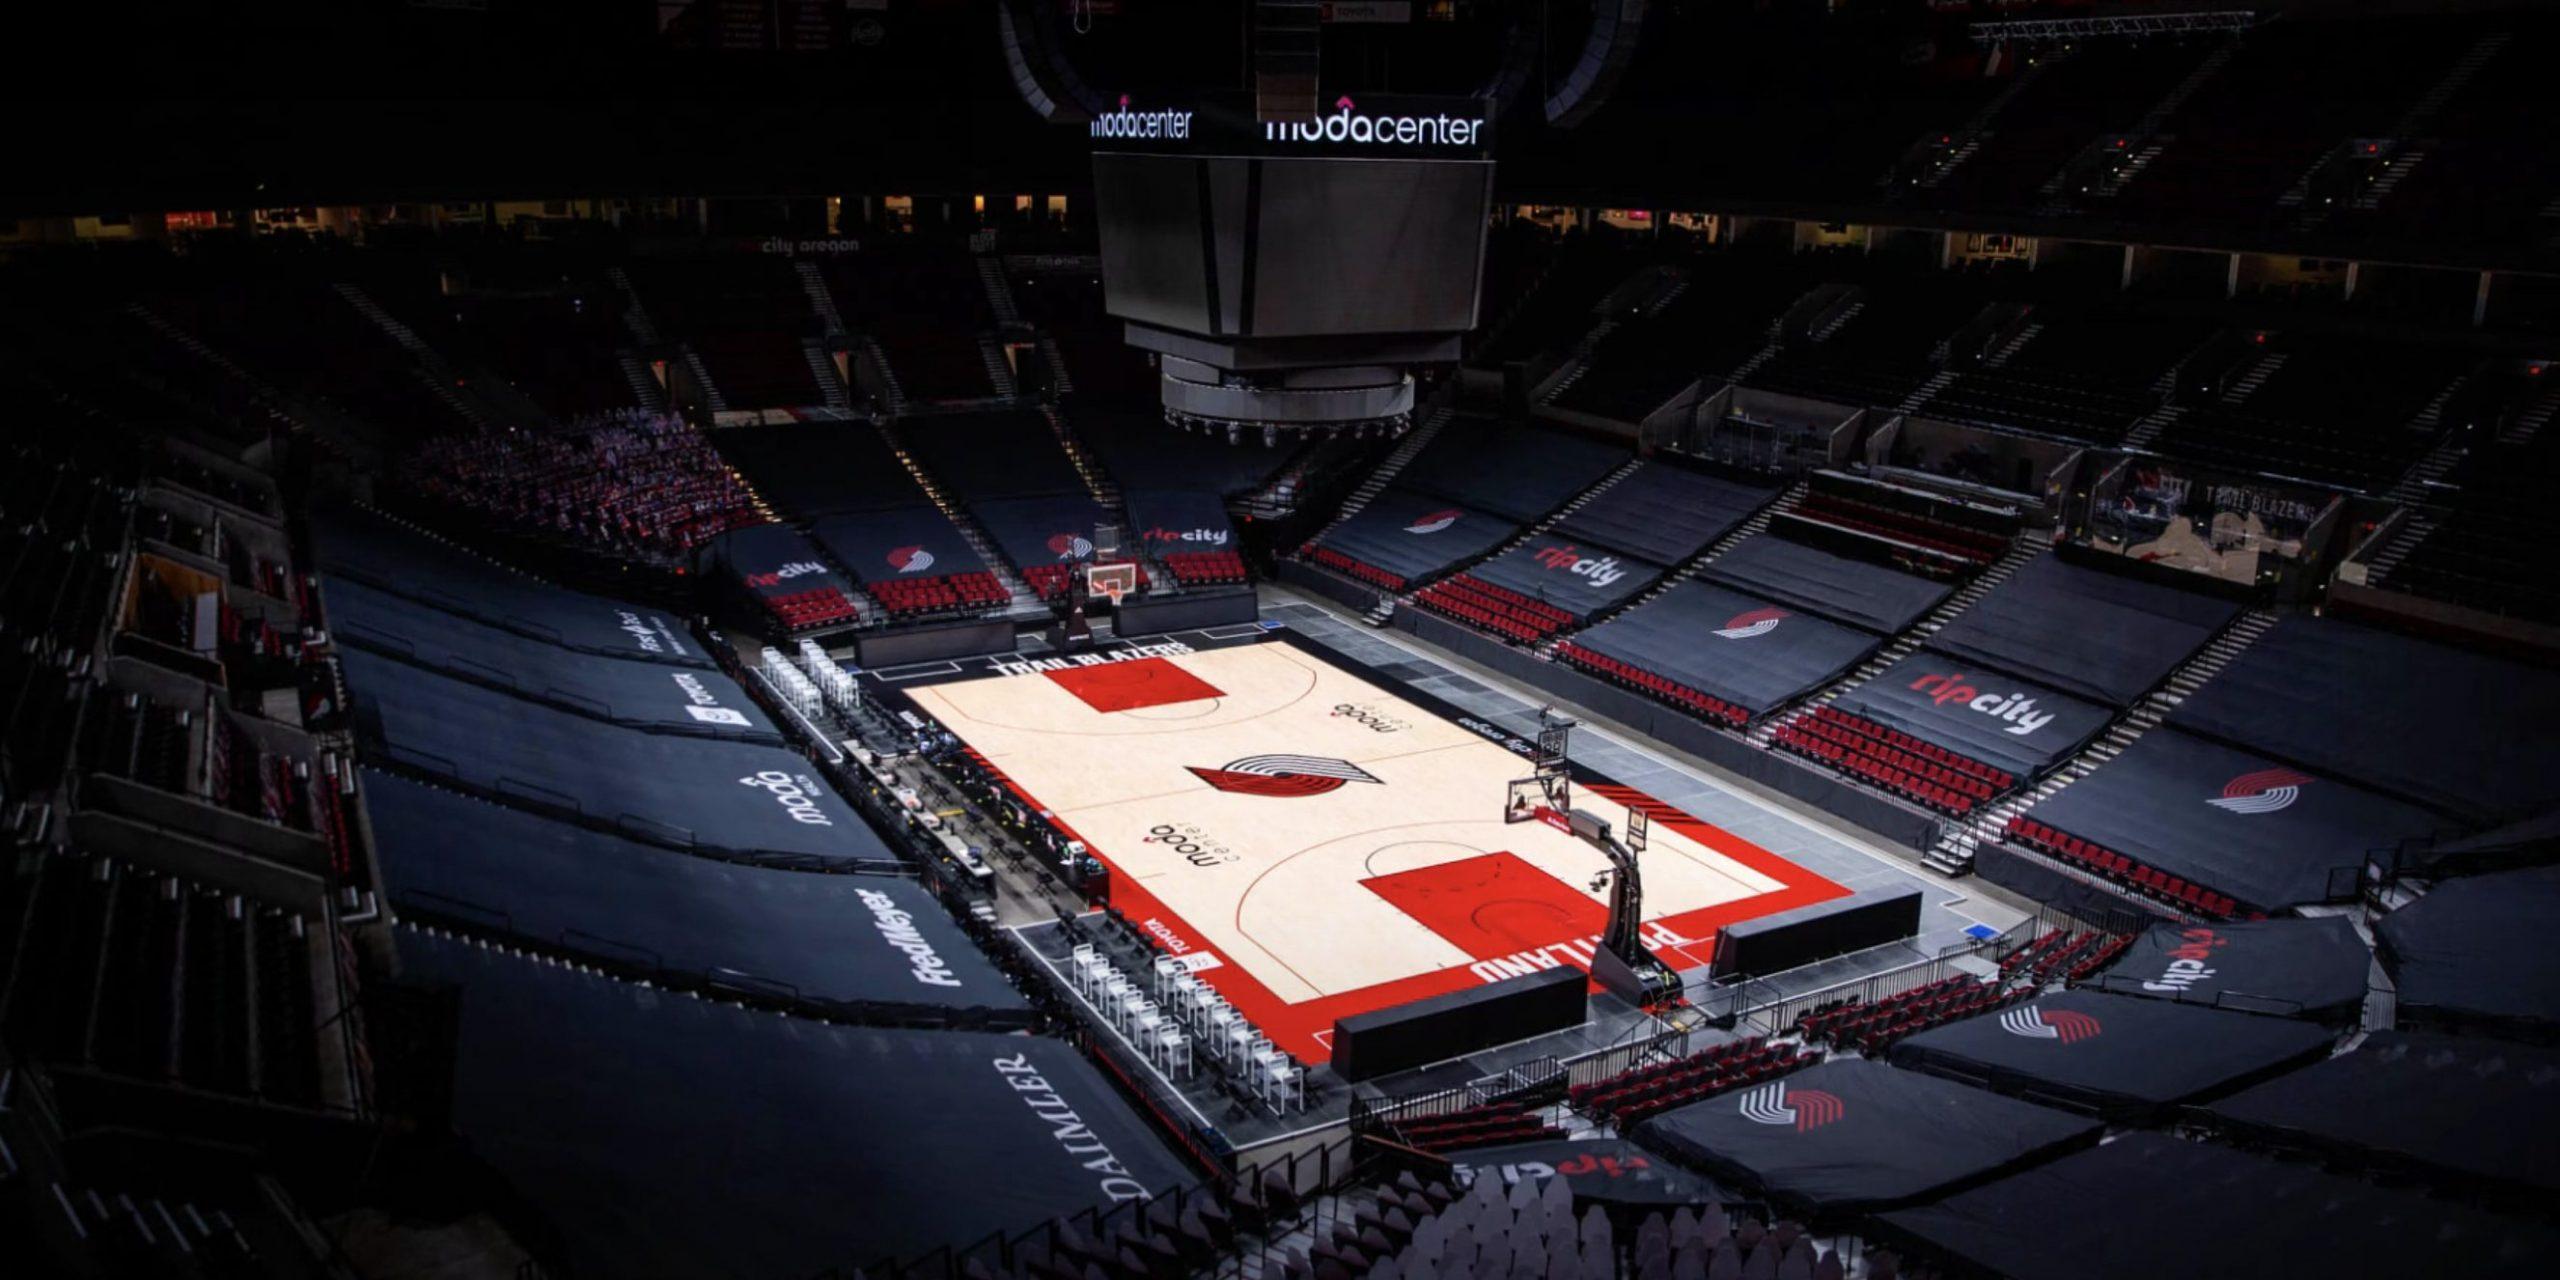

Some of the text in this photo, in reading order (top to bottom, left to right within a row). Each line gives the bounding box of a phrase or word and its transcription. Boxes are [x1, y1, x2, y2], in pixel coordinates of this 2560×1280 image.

[986, 641, 1197, 677] TRAIL BLAZERS
[1333, 703, 1398, 733] moda
[1909, 672, 2057, 736] ripcity
[752, 770, 834, 826] moda
[1149, 824, 1221, 867] moda
[1143, 917, 1192, 955] TOYOTA
[992, 1052, 1154, 1203] DAIMLER
